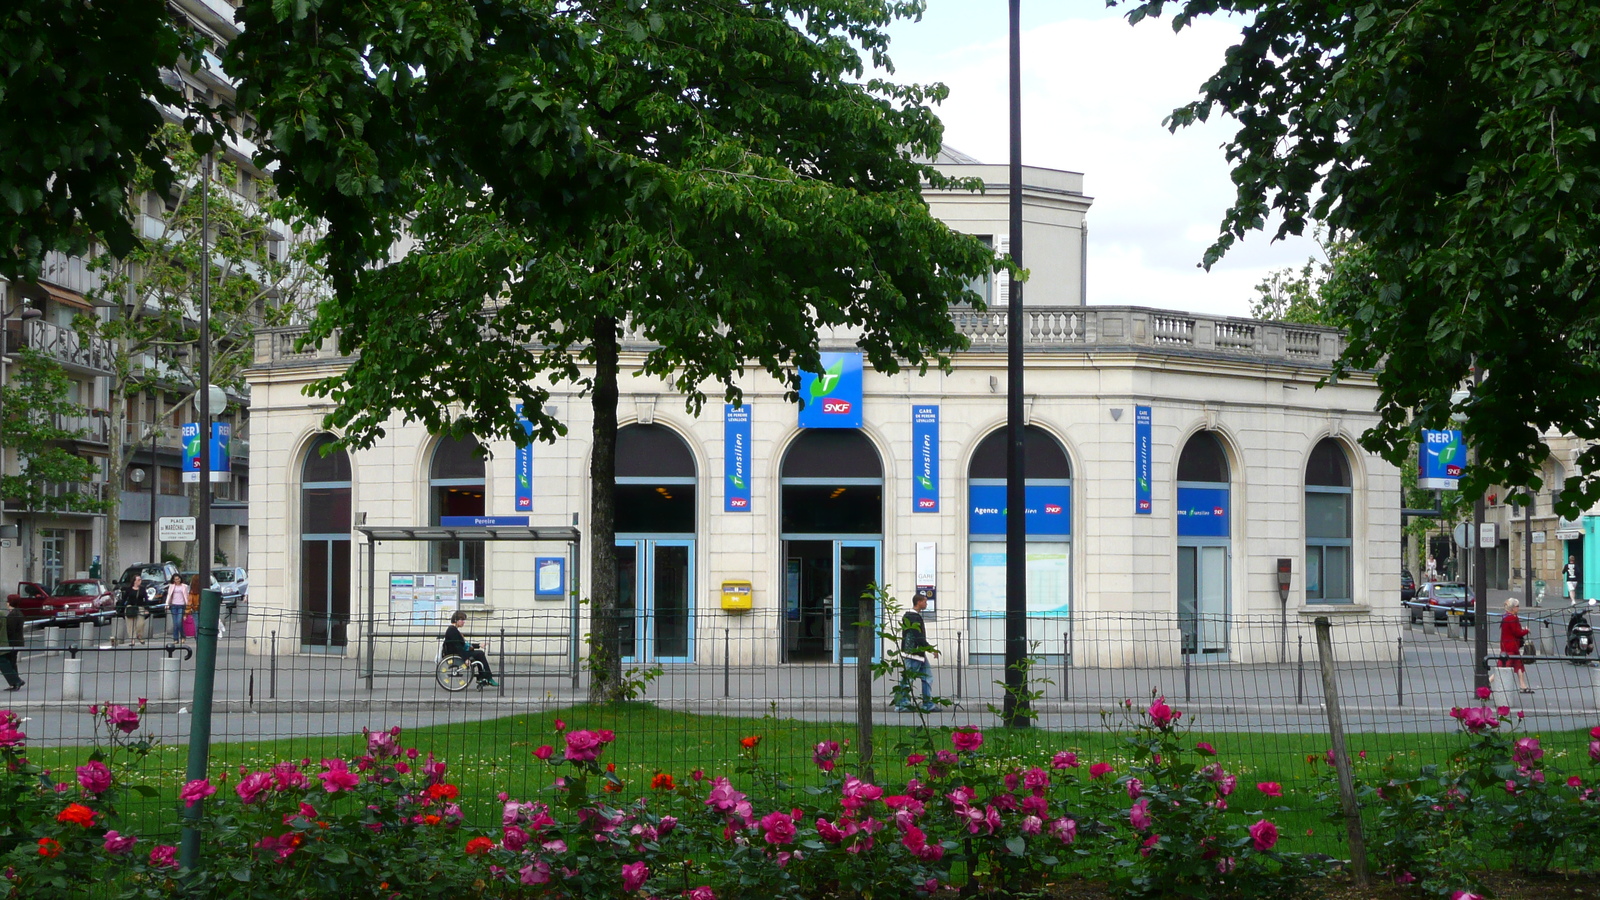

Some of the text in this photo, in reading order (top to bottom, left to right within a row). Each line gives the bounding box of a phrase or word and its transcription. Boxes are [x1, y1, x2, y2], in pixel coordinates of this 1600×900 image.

[824, 404, 850, 412] SNCF
[1427, 433, 1449, 443] RER
[734, 433, 743, 485] Transilien
[922, 434, 931, 485] Transilien
[974, 507, 998, 515] Agence
